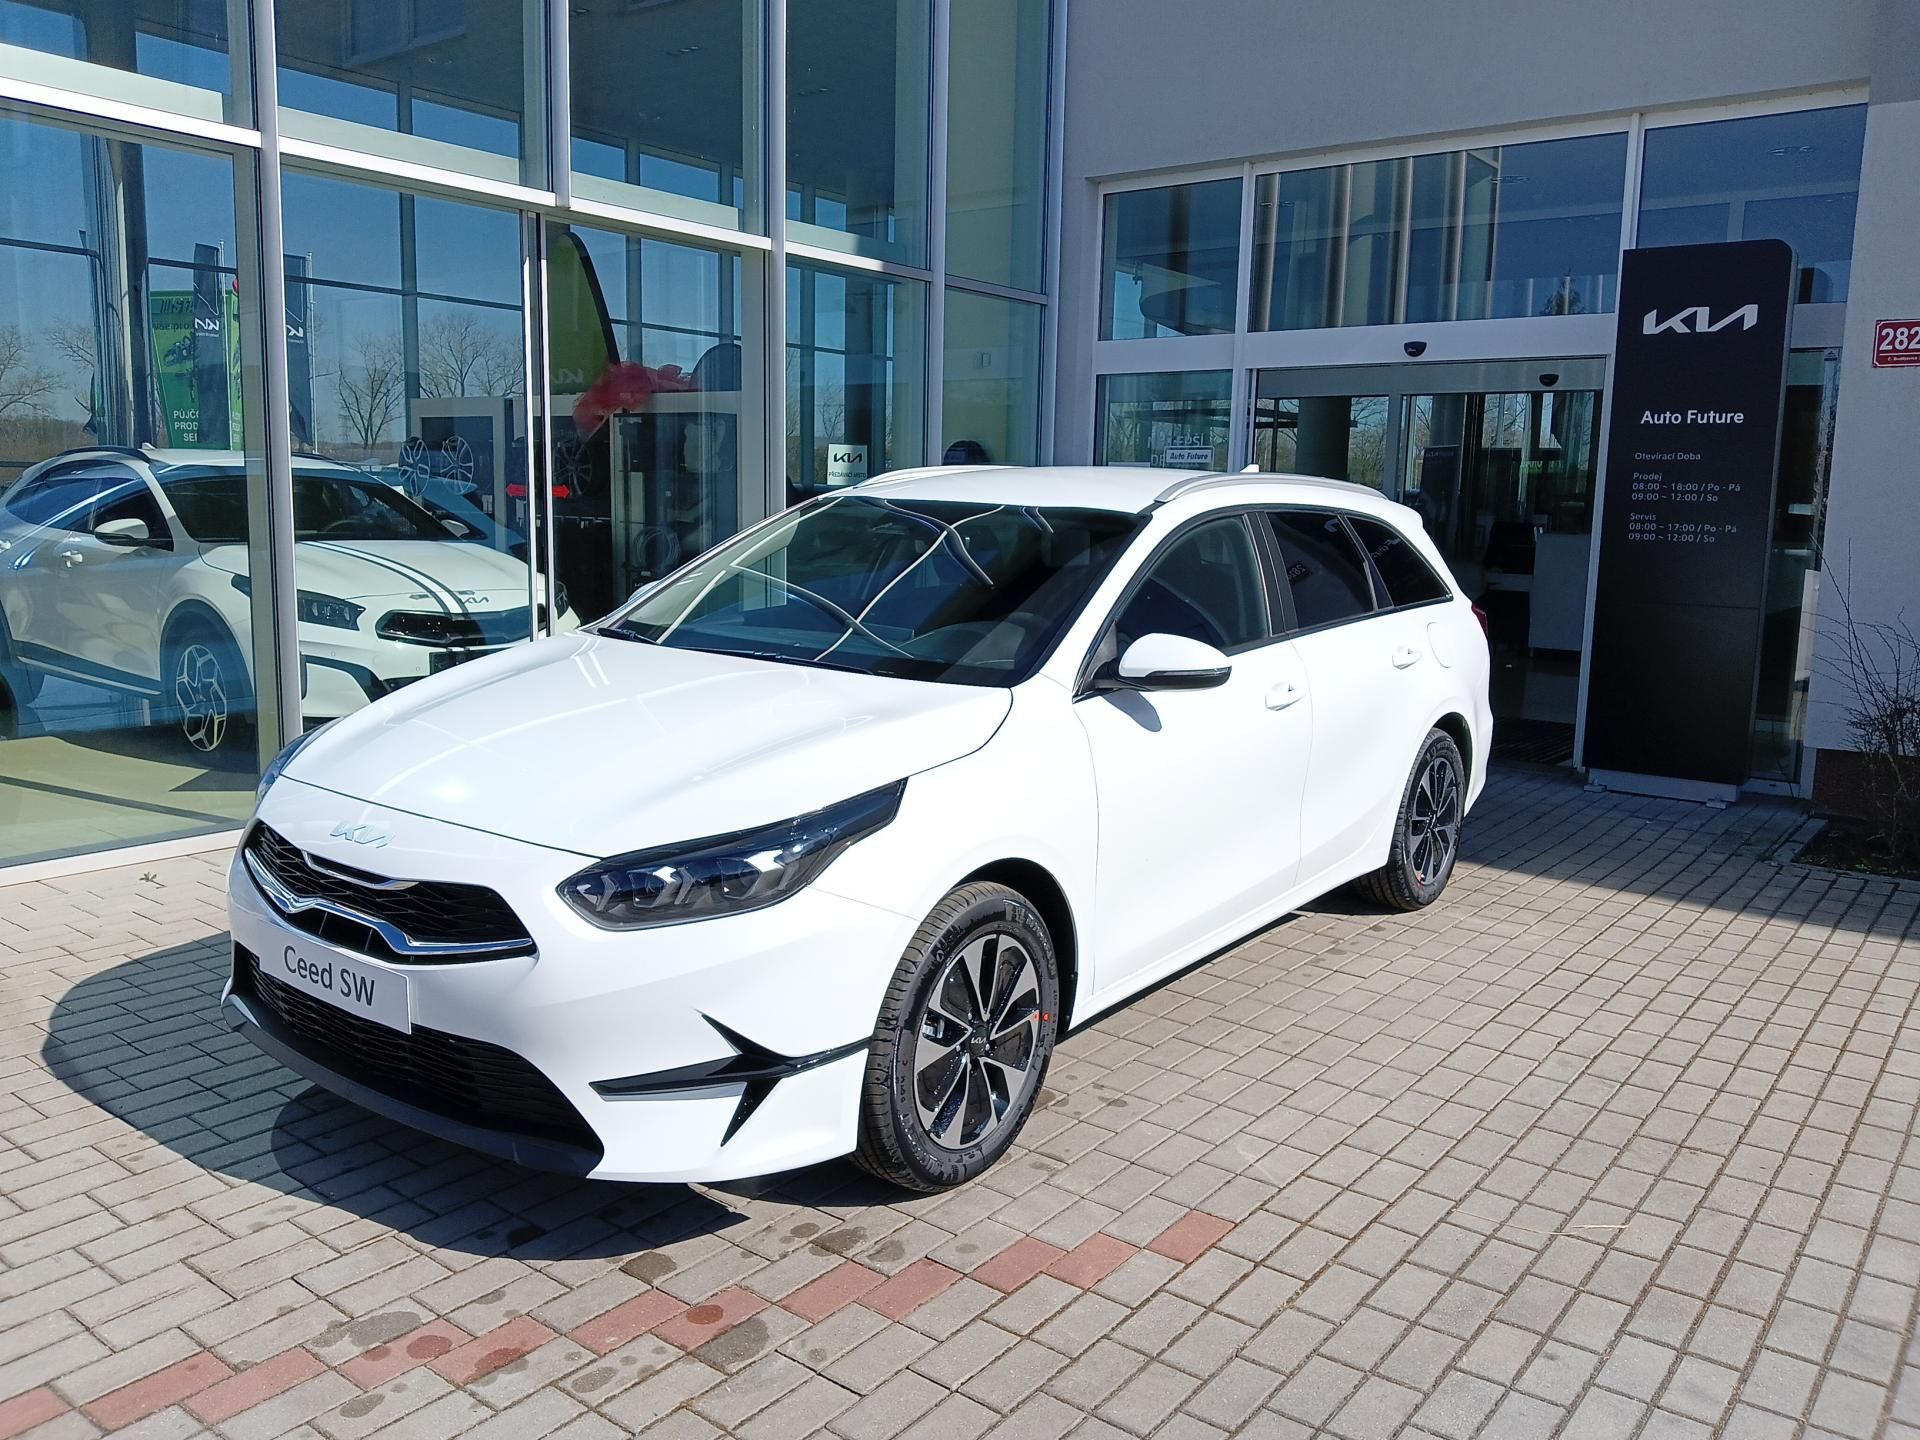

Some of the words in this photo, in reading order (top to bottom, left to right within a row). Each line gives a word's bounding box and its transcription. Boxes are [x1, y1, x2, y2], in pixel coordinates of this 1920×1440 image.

[1642, 303, 1759, 335] KIA
[1879, 326, 1920, 351] 282
[1640, 410, 1682, 425] Auto
[1686, 409, 1745, 424] Future
[833, 452, 863, 463] KIA
[1169, 451, 1185, 460] Auto
[1186, 451, 1209, 460] Future
[1677, 452, 1701, 461] Doba
[1632, 472, 1662, 482] Prodej
[1632, 482, 1660, 491] 08:00
[1671, 483, 1699, 491] 18:00
[1707, 483, 1720, 492] Po
[1631, 493, 1659, 501] 09:00
[1671, 493, 1698, 502] 12:00
[1706, 494, 1719, 502] So
[1630, 512, 1657, 521] Servis
[1629, 523, 1657, 531] 08:00
[1667, 523, 1695, 532] 17:00
[1704, 524, 1717, 533] Po
[1628, 532, 1656, 541] 09:00
[1667, 533, 1694, 542] 12:00
[1703, 534, 1715, 543] So
[329, 821, 397, 849] KIA
[283, 945, 334, 991] Ceed
[339, 967, 375, 1007] SW
